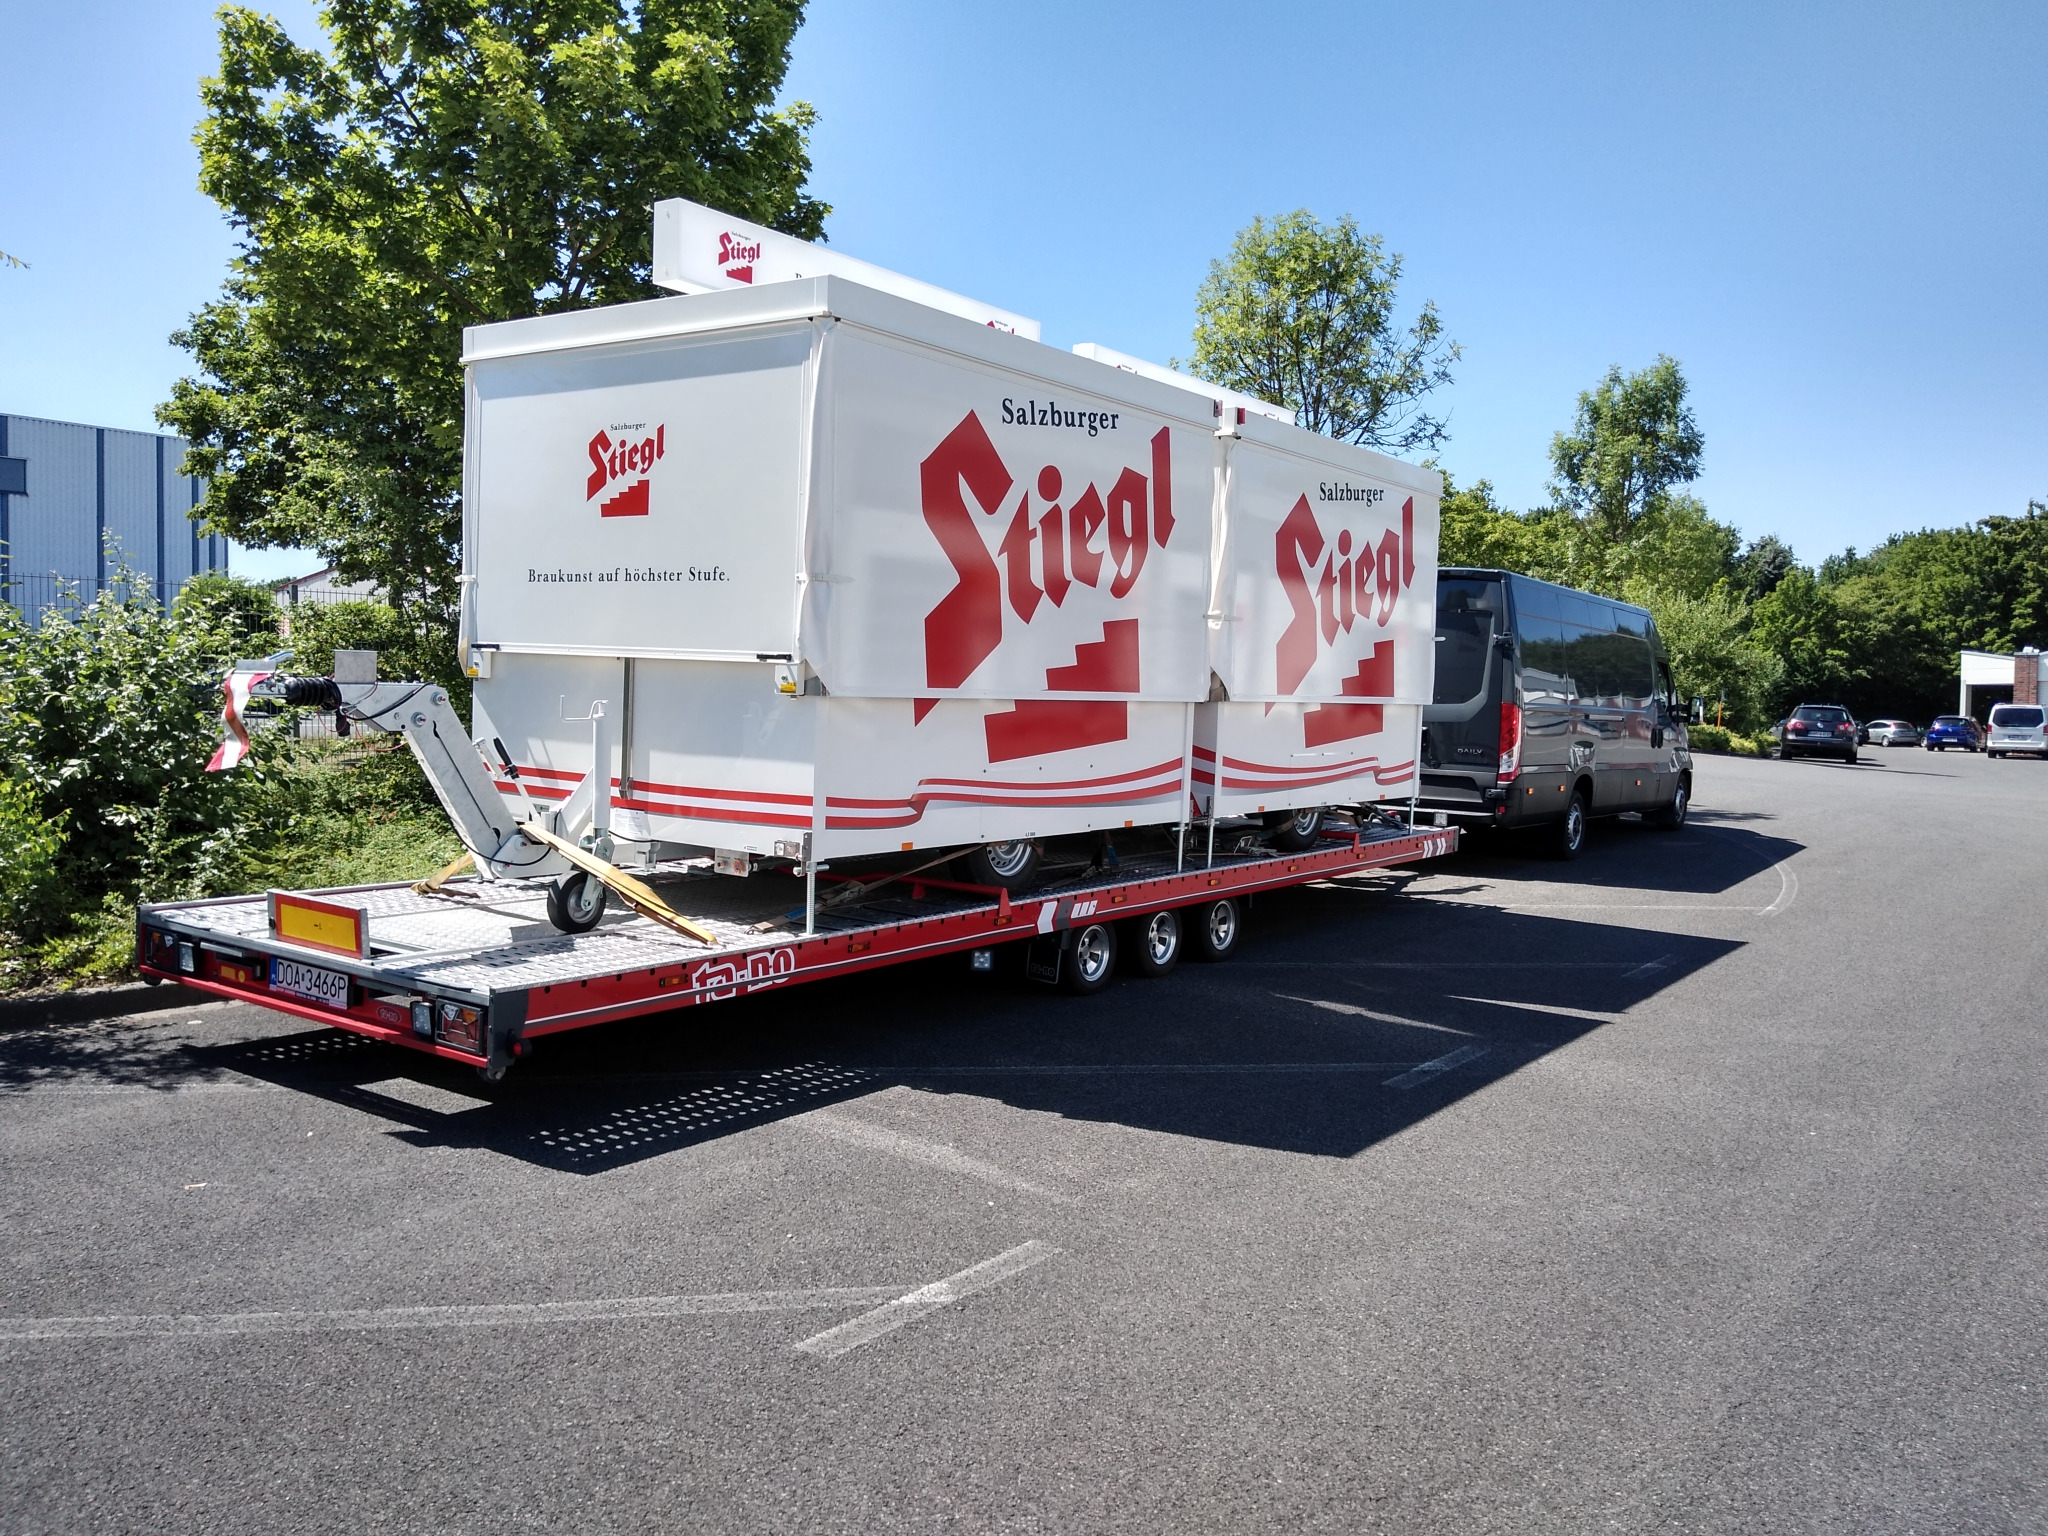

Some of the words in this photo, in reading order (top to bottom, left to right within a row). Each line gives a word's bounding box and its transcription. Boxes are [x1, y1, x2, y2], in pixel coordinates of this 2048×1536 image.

[718, 232, 761, 265] Stiegl
[610, 422, 647, 432] Salzburger
[1001, 398, 1119, 437] Salzburger
[586, 423, 665, 502] Stiegl
[1319, 482, 1385, 507] Salzburger
[920, 408, 1176, 689] Stiegl
[528, 569, 593, 583] Braukunst
[598, 568, 621, 583] auf
[624, 568, 683, 582] höchster
[688, 566, 730, 582] Stufe.
[1276, 492, 1416, 695] Stiegl
[277, 961, 301, 990] DOA
[306, 968, 347, 999] 3466P
